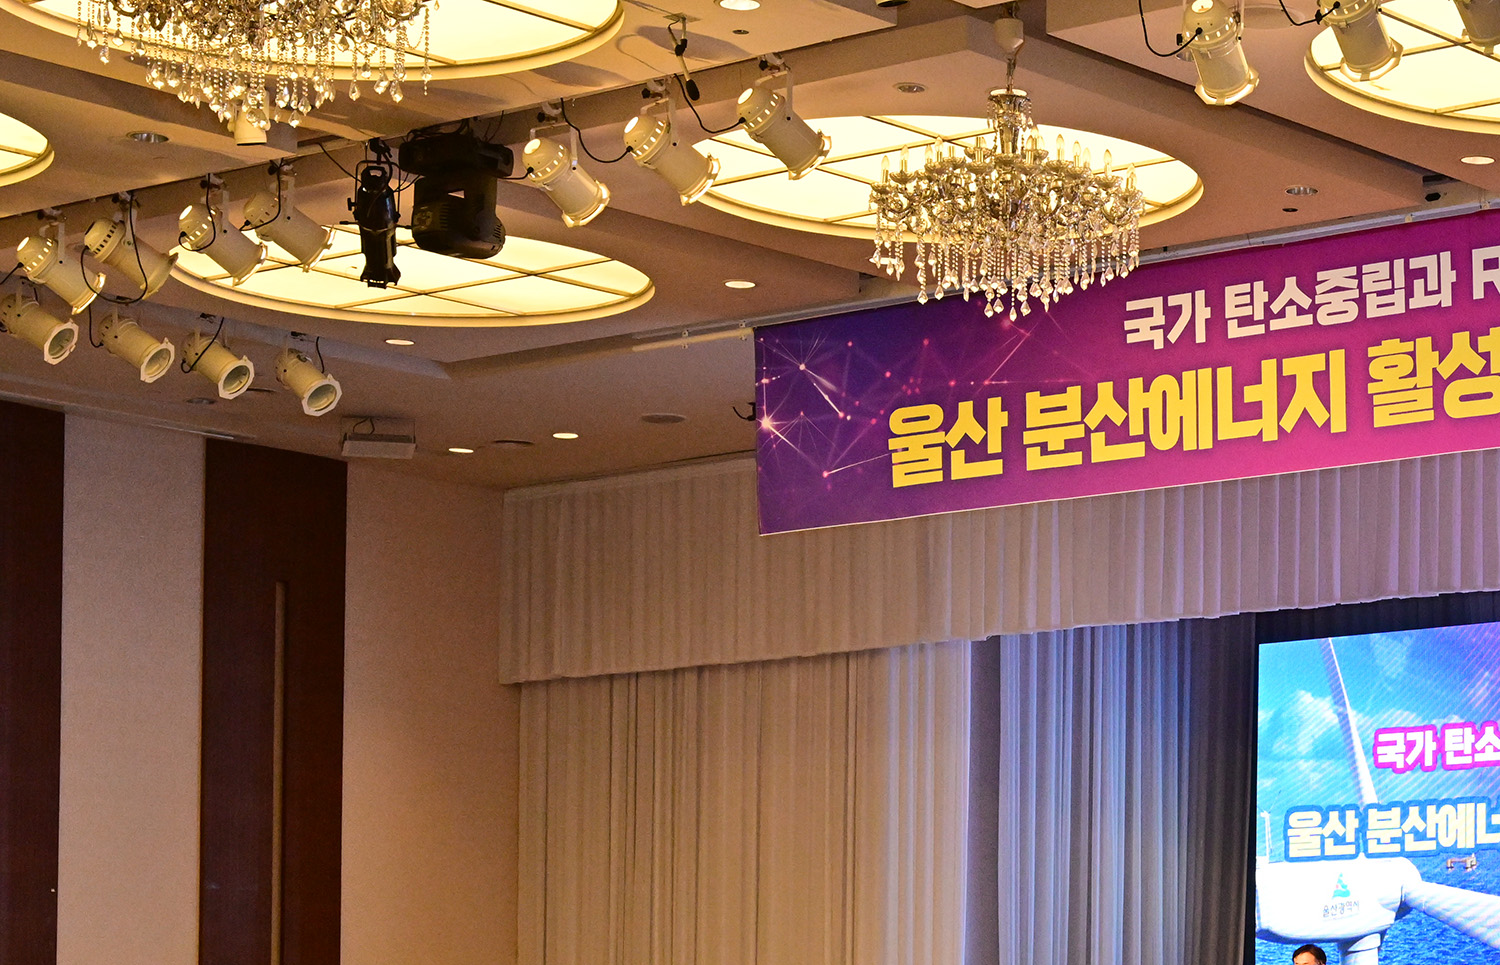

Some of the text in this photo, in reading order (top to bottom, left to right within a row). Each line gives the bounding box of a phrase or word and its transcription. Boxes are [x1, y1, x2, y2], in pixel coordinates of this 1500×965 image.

[1123, 290, 1212, 350] 국가
[1224, 251, 1457, 340] 탄소중립과
[887, 400, 1010, 489] 울산
[1022, 348, 1348, 471] 분산에너지
[1377, 731, 1437, 768] 국가
[1286, 811, 1359, 855] 울산
